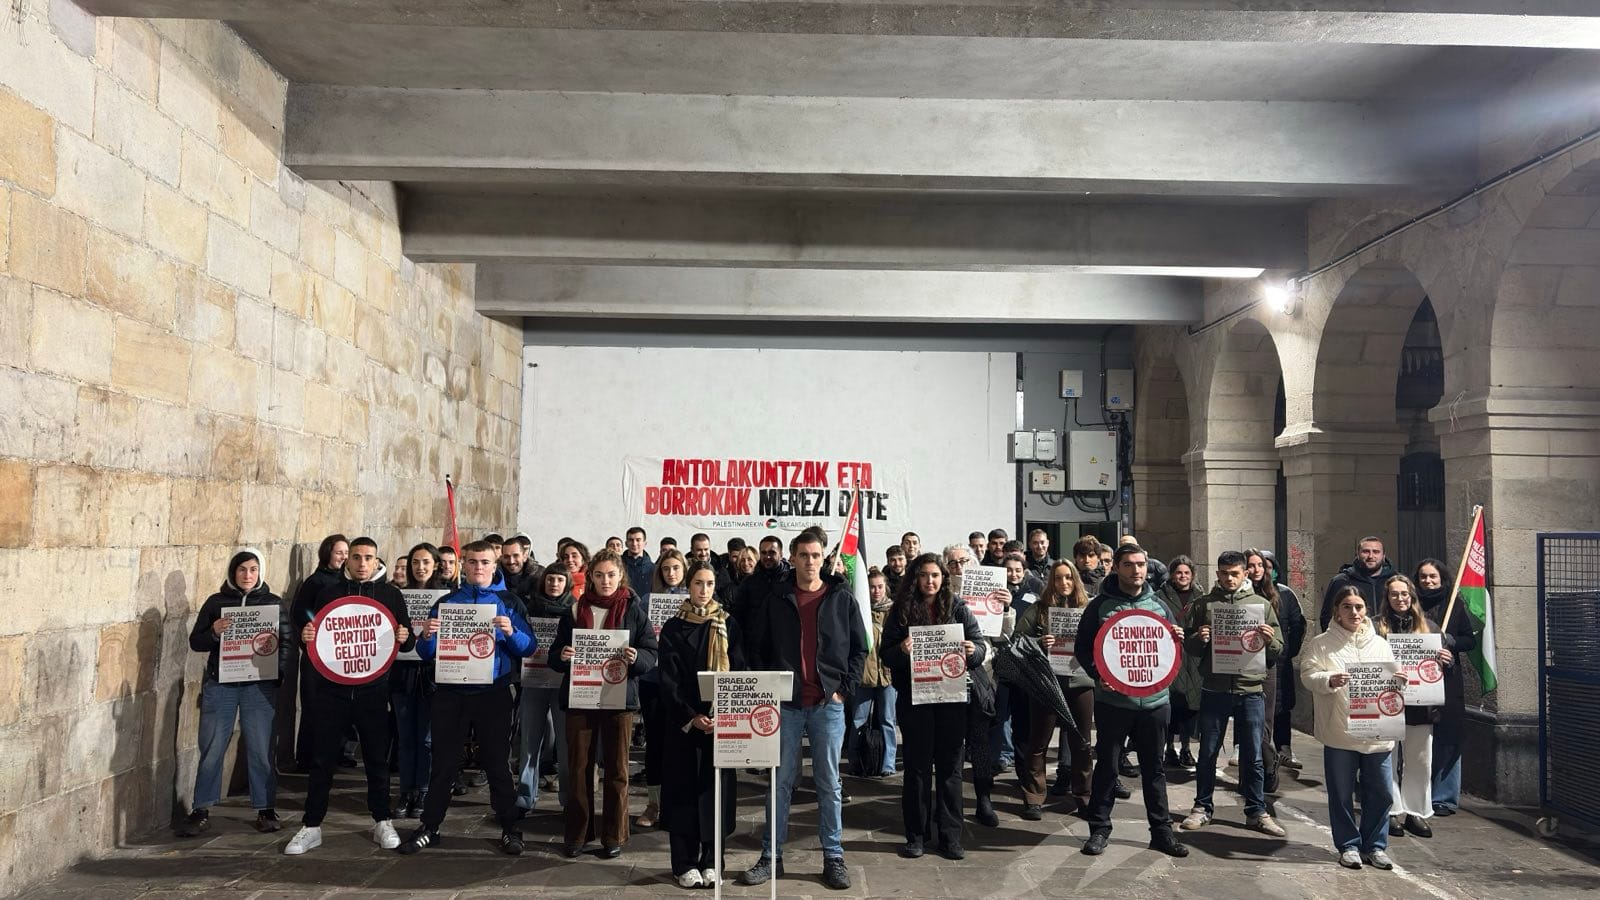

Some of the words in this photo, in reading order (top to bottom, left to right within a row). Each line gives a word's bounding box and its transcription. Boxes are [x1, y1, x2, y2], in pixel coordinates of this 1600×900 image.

[662, 458, 829, 488] ANTOLAKUNTZAK
[837, 462, 872, 490] ETA
[645, 486, 750, 516] BORROKAK
[758, 488, 830, 517] MEREZI
[325, 613, 382, 631] GERNIKAKO
[334, 629, 376, 645] PARTIDA
[1112, 626, 1164, 640] GERNIKAKO
[335, 643, 376, 660] GELDITU
[1119, 640, 1158, 653] PARTIDA
[344, 659, 370, 674] DUGU
[1120, 655, 1159, 668] GELDITU
[1128, 669, 1152, 682] DUGU
